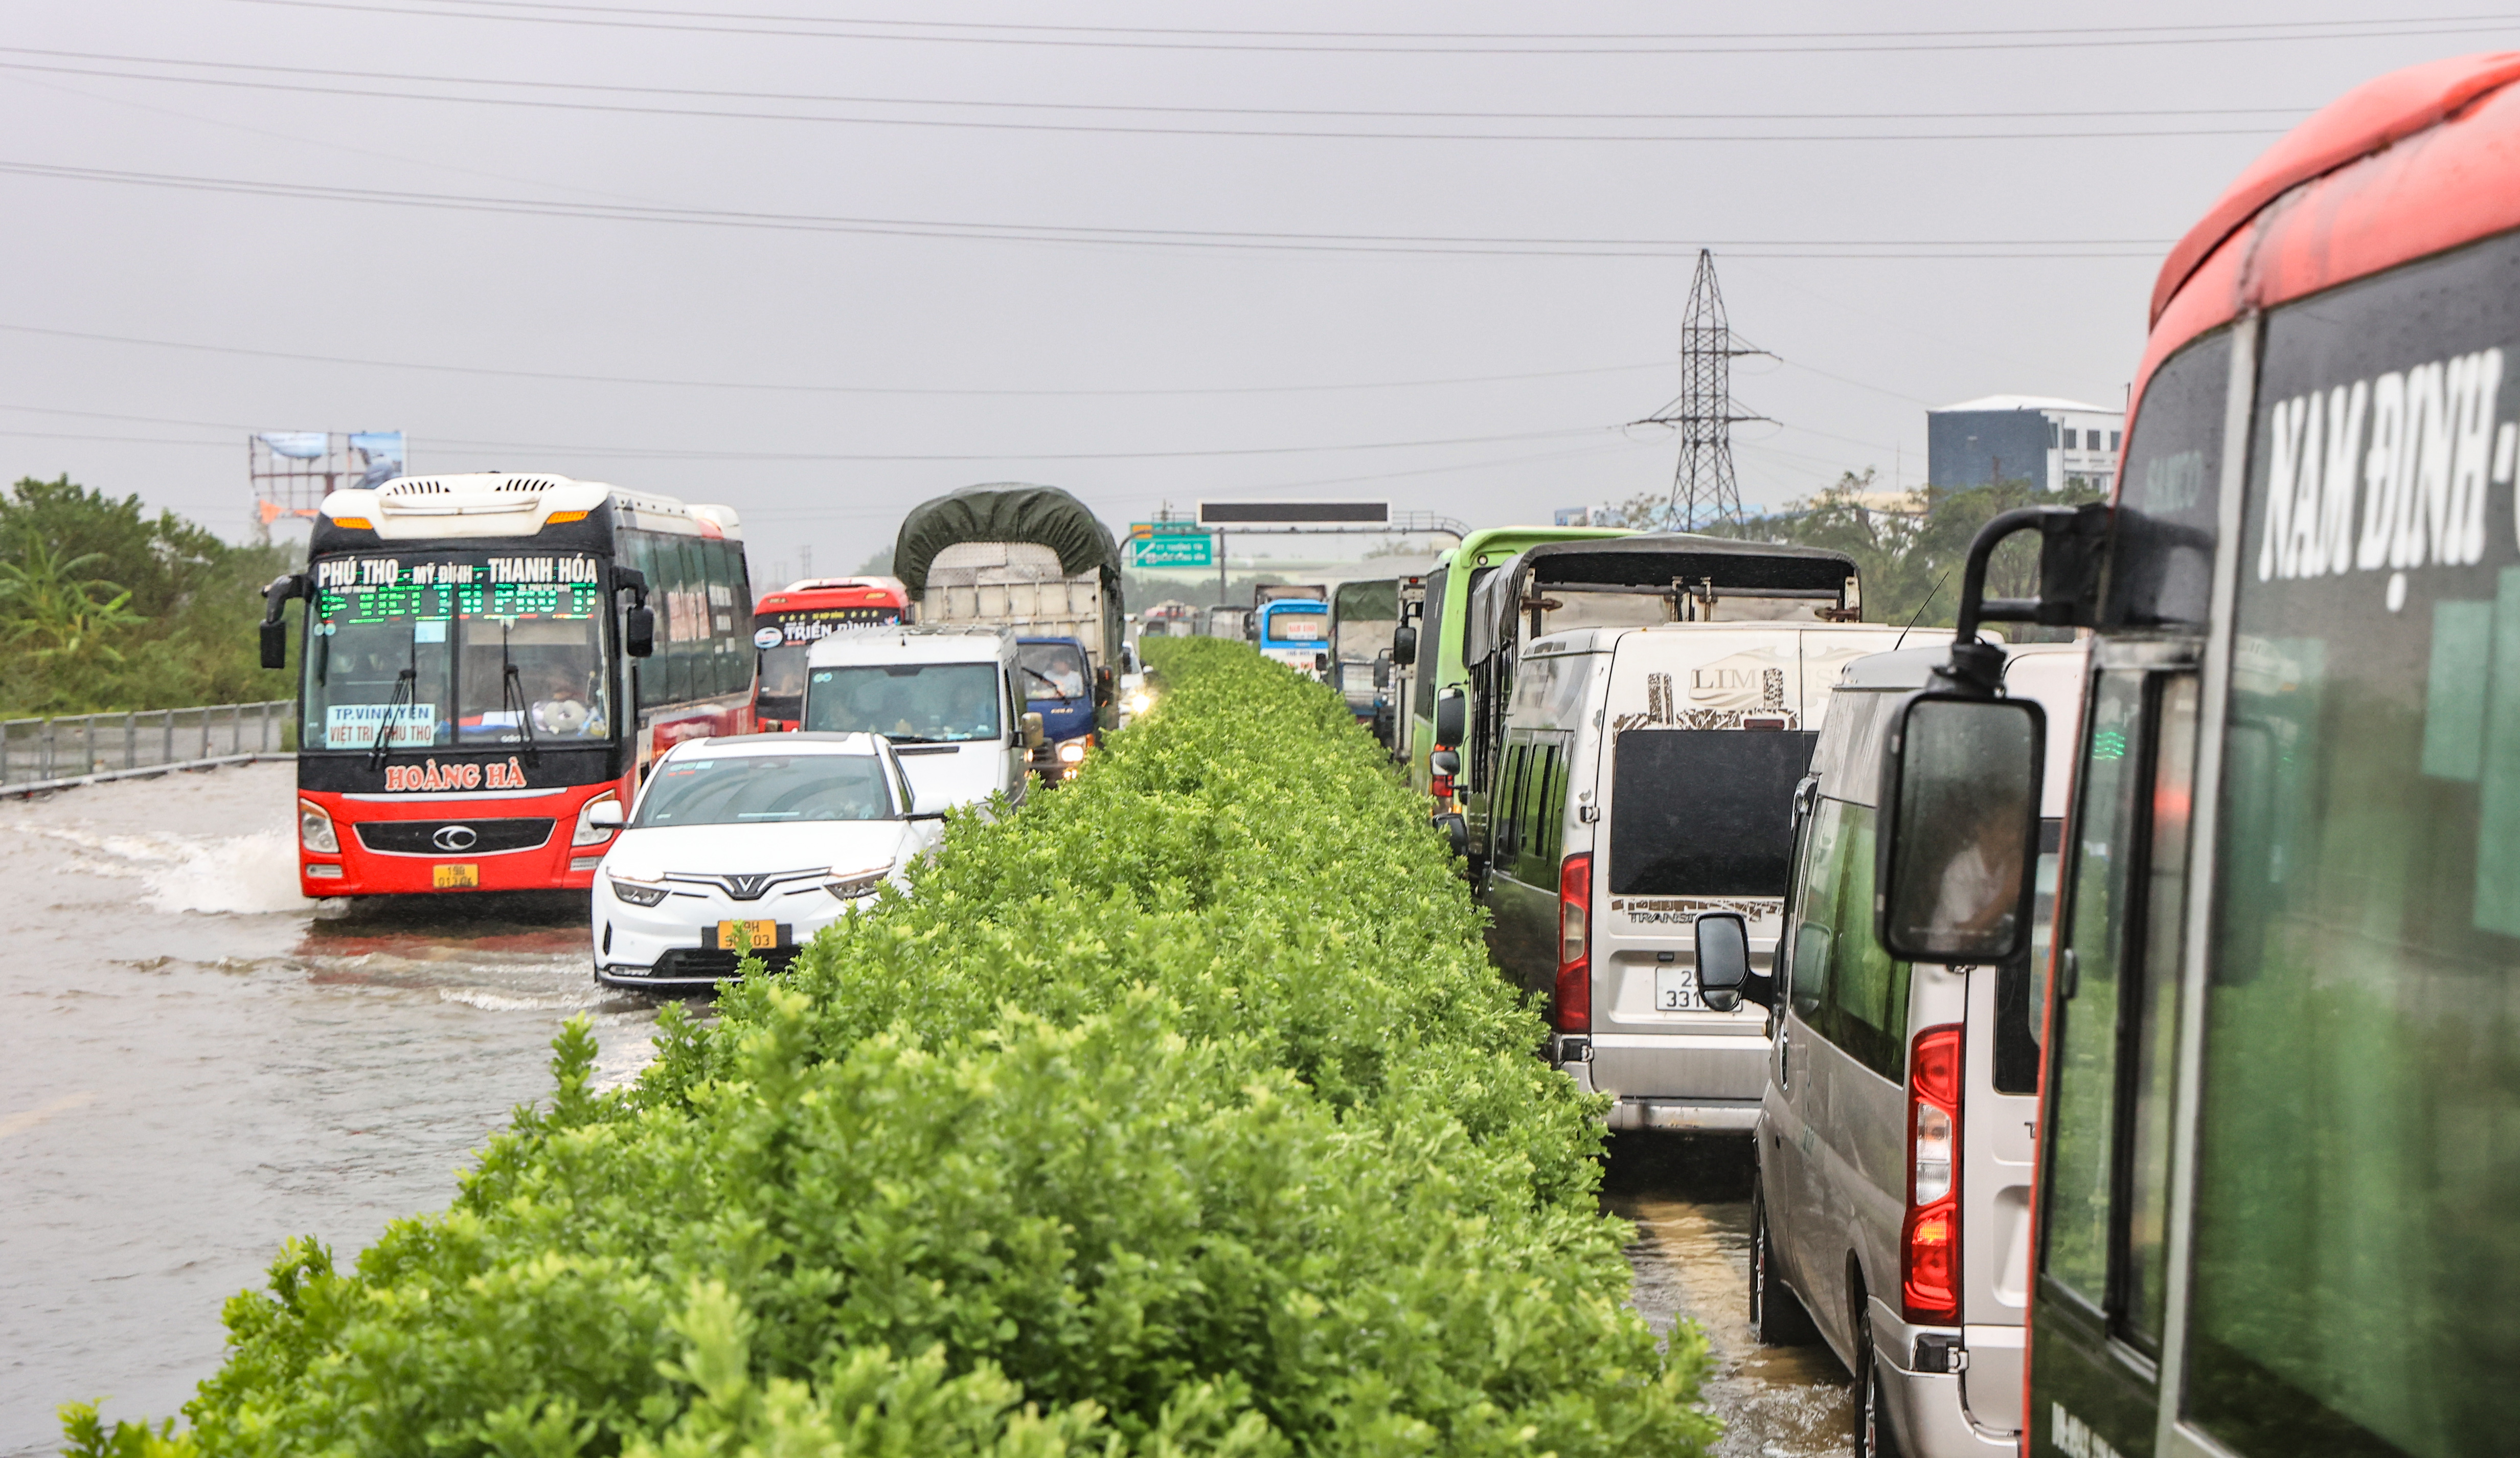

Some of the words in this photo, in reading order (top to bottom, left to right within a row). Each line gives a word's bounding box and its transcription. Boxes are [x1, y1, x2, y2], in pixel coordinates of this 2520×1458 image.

[2258, 378, 2368, 582] NAM
[318, 555, 357, 588] PHÚ
[361, 558, 399, 588] THỌ
[413, 562, 436, 584] MỸ
[438, 561, 473, 584] ĐÌNH
[488, 557, 553, 584] THANH
[558, 552, 598, 584] HÓA
[330, 724, 353, 745] VIỆT
[357, 722, 374, 742] TRÌ
[384, 722, 407, 742] PHÚ
[411, 725, 432, 744] THỌ
[1628, 912, 1699, 924] TRANSI
